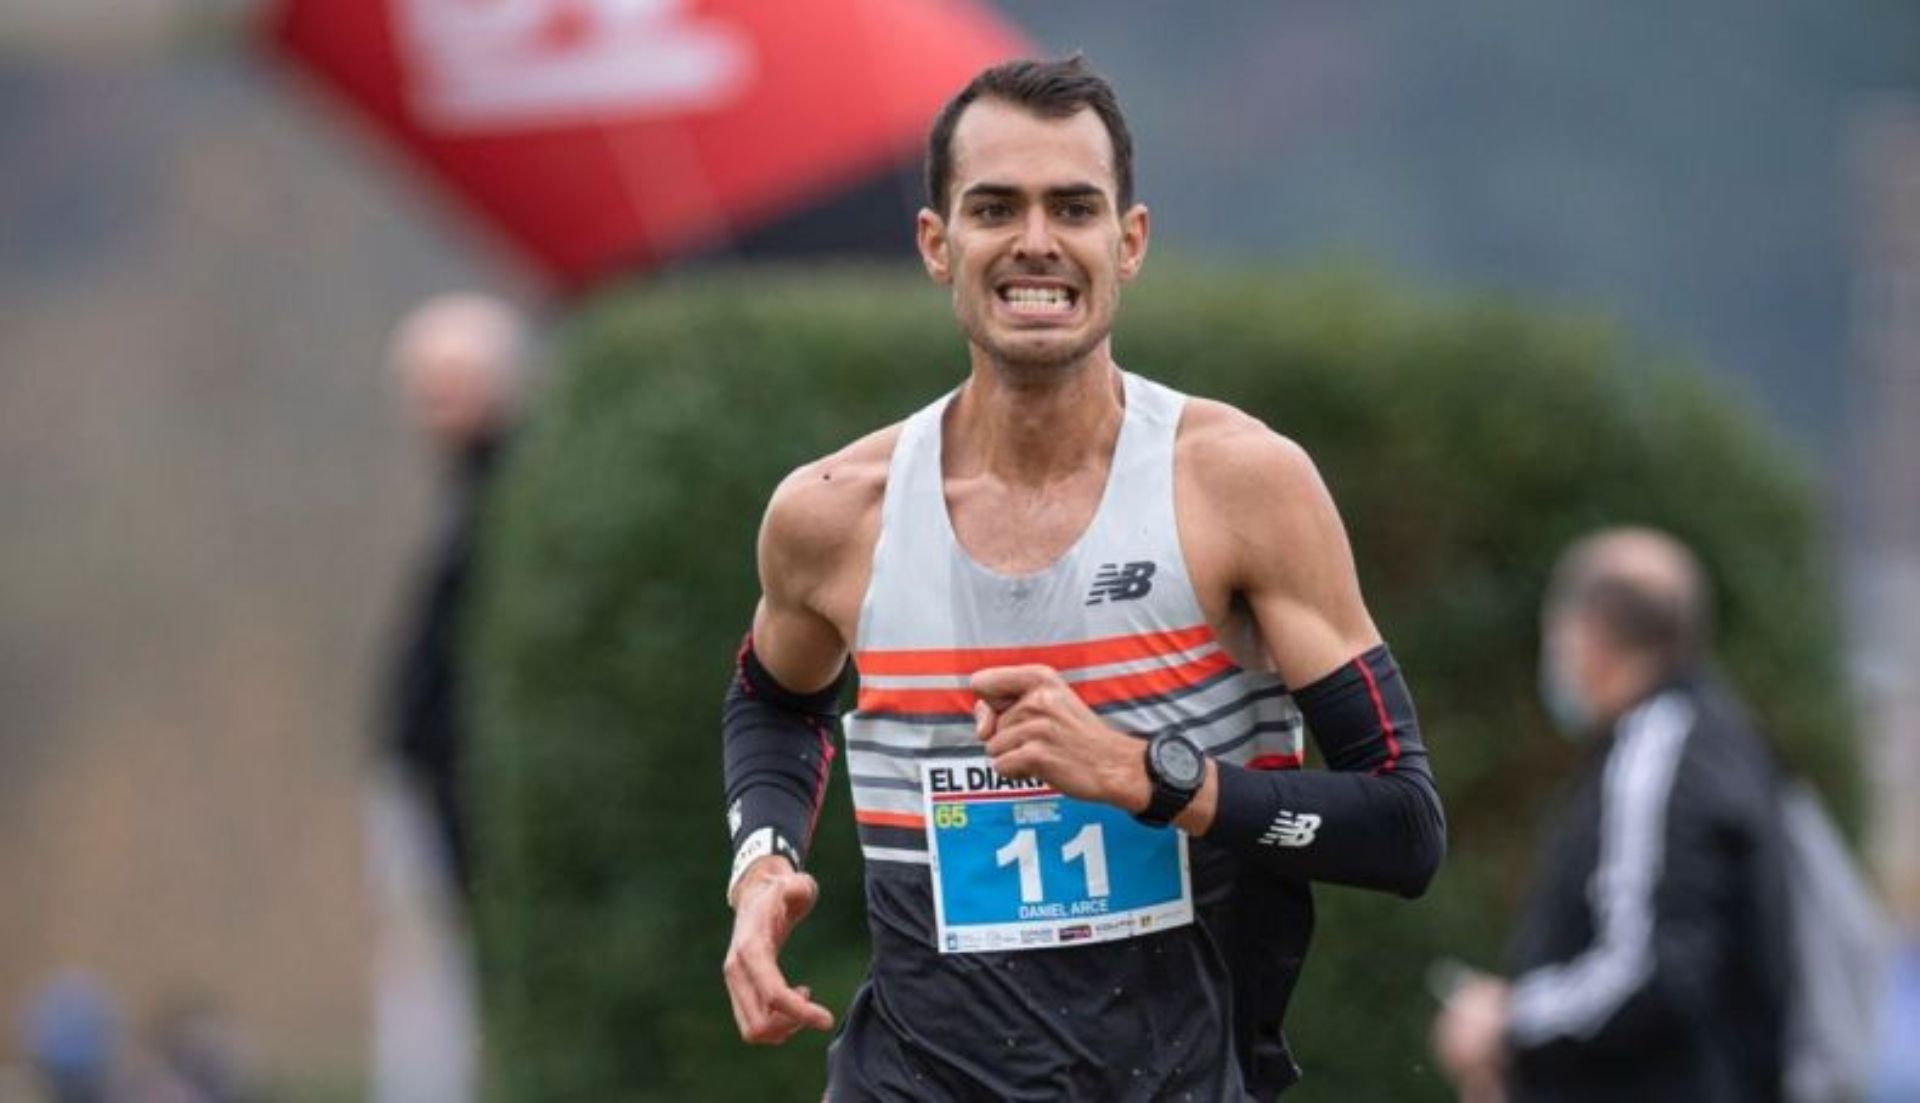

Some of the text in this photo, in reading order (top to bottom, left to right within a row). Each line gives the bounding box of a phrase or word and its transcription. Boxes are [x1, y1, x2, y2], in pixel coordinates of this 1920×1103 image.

[930, 768, 962, 791] EL
[936, 802, 968, 828] 65
[997, 823, 1109, 902] 11
[1020, 898, 1109, 919] DANIEL ARCE
